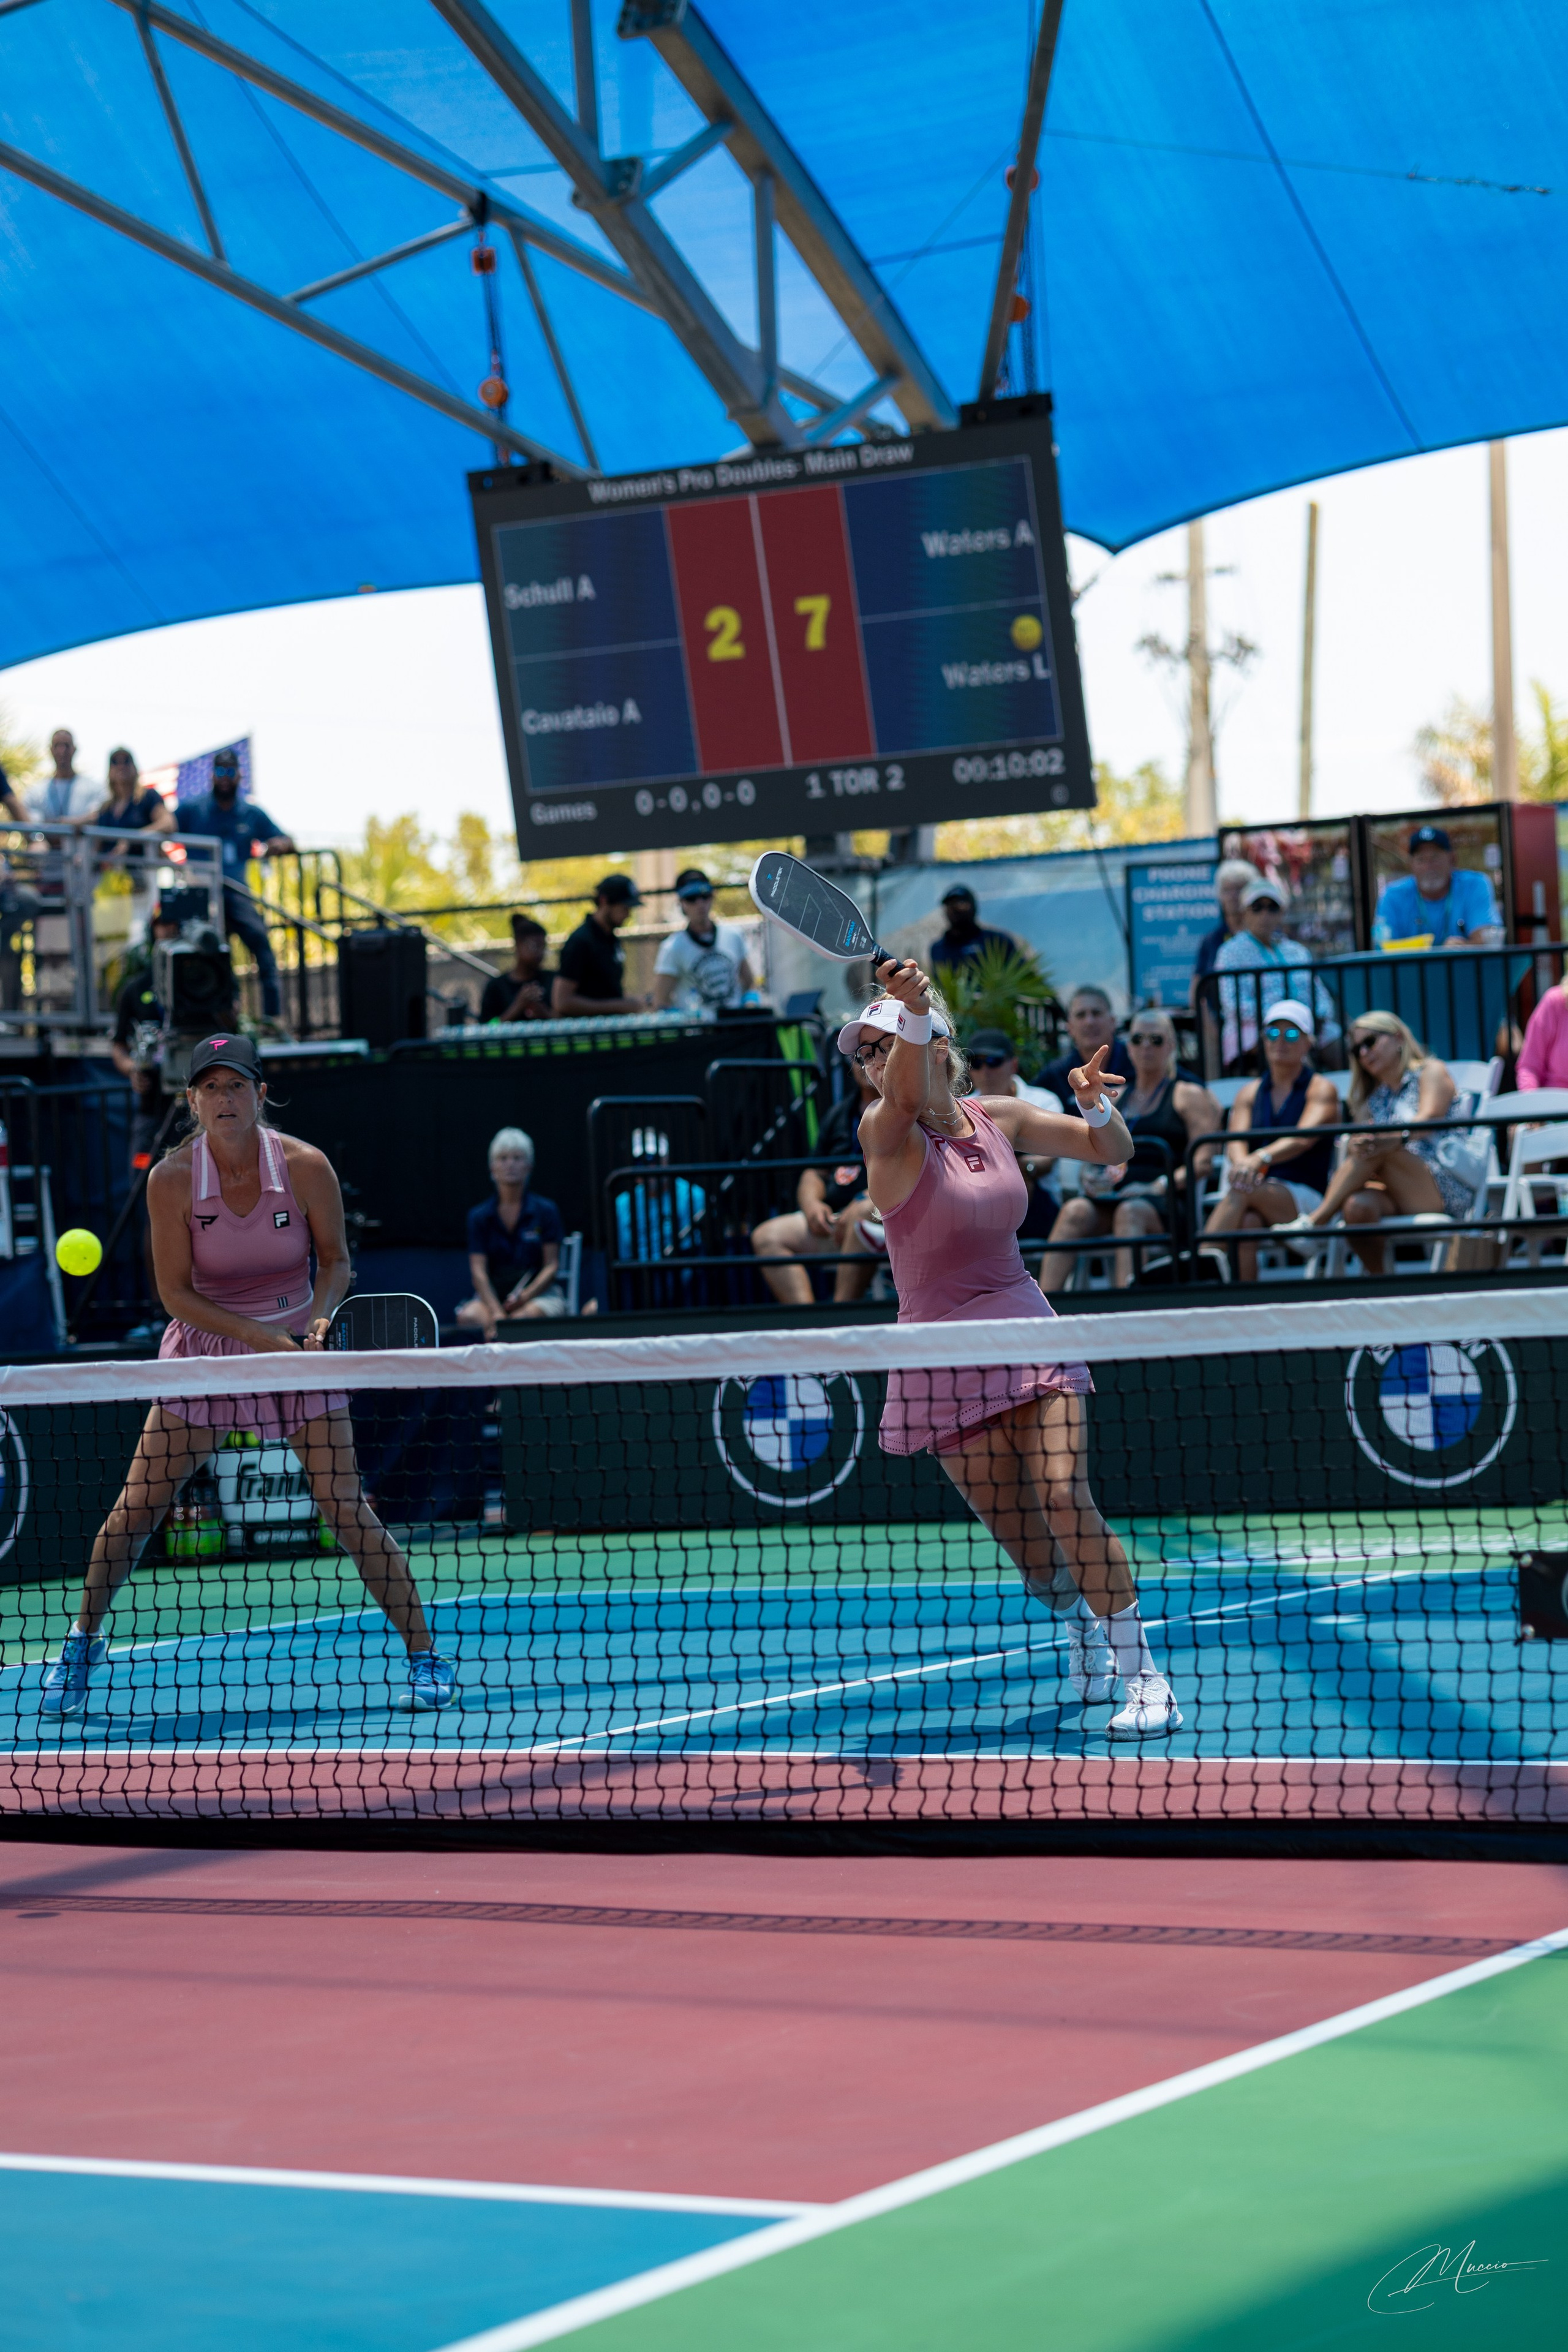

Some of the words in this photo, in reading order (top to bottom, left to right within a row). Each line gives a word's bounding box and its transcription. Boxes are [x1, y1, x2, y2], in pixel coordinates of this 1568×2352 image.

[588, 472, 676, 503] Women's
[678, 468, 714, 492] Pro
[804, 448, 858, 475] Main
[859, 443, 914, 469] Draw
[921, 527, 1011, 558] Waters
[1014, 519, 1035, 548] A
[577, 575, 596, 601] A
[706, 605, 745, 663] 2
[794, 594, 831, 651] 7
[941, 660, 1031, 689] Waters
[1033, 653, 1051, 679] L
[622, 698, 642, 724] A
[806, 772, 826, 799] 1
[828, 767, 880, 796] TOR
[885, 764, 905, 791] 2
[952, 747, 1066, 784] 00:10:02
[530, 801, 598, 825] Games
[1148, 866, 1210, 883] PHONE
[1133, 884, 1216, 903] CHARGIN
[1142, 903, 1219, 922] STATION
